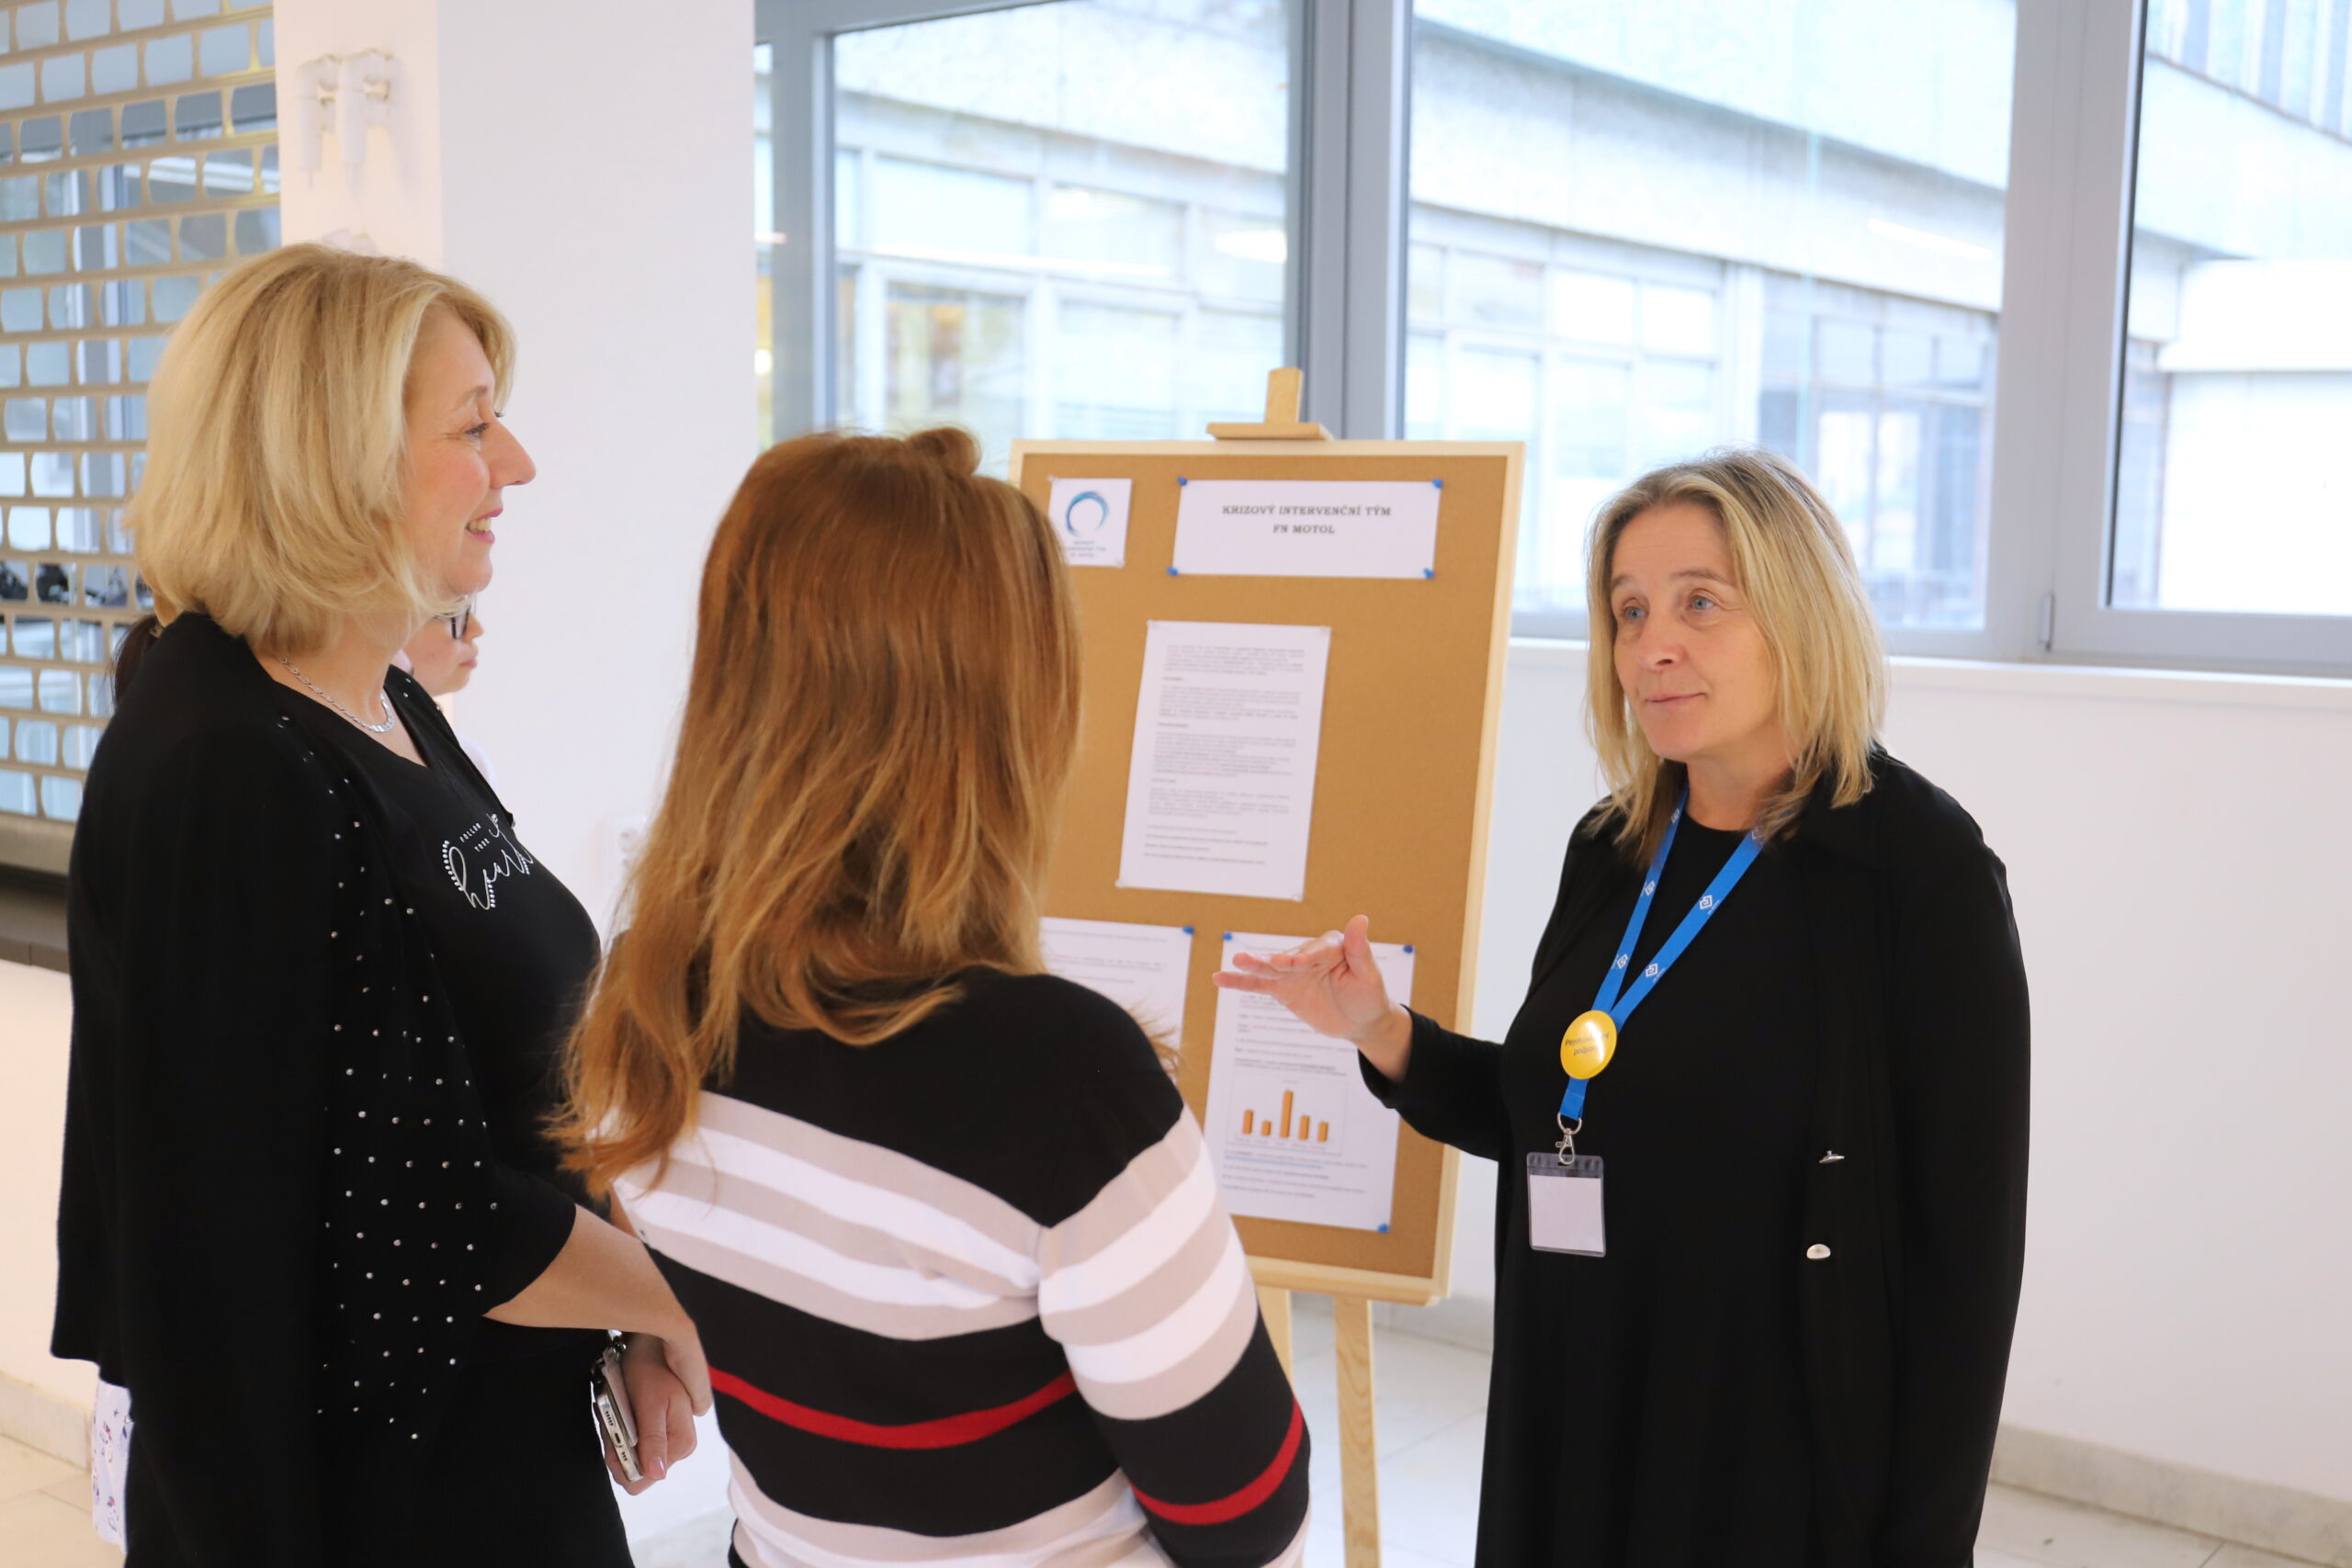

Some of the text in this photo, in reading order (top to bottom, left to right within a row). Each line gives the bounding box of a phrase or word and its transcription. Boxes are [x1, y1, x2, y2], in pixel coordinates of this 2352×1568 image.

[1222, 503, 1392, 516] KRIZOVÝ INTERVENČNÍ TÝM
[1272, 524, 1335, 534] FN MOTOL
